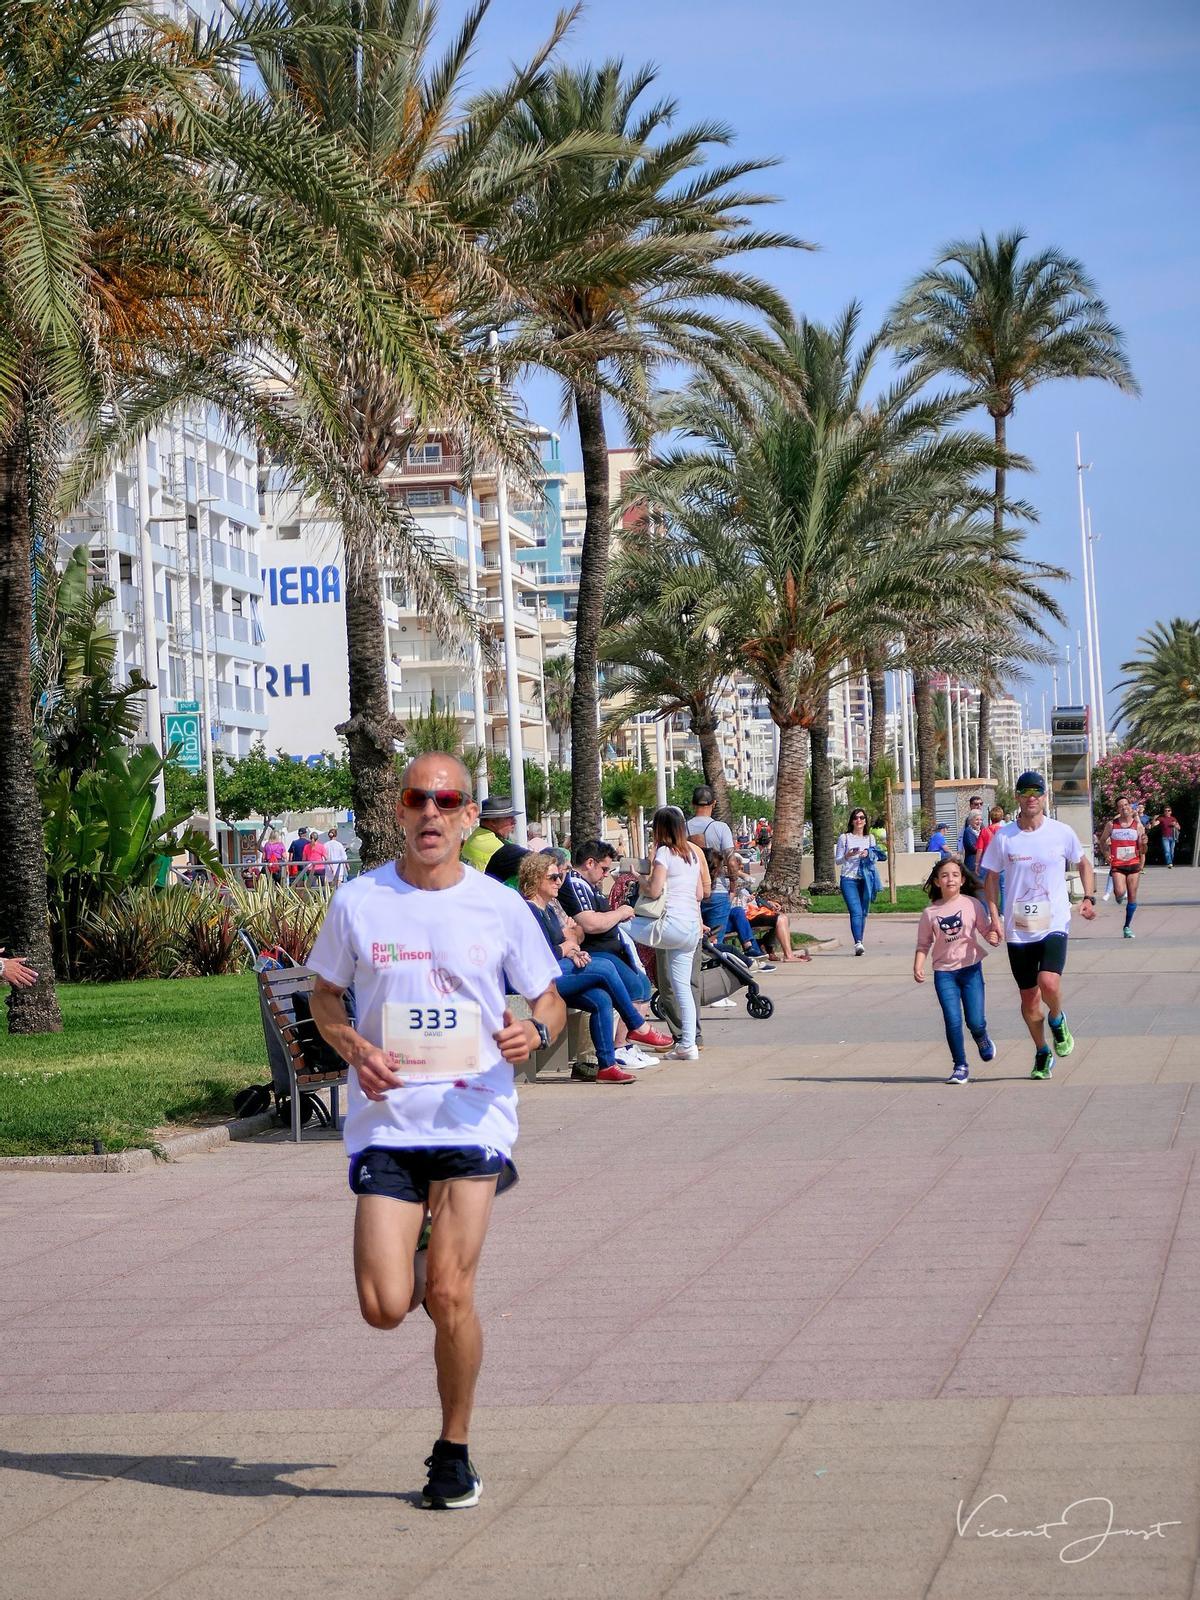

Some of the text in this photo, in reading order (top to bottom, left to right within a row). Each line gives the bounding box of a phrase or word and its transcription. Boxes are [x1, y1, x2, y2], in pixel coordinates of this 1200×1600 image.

[169, 720, 198, 737] AQ
[1024, 904, 1039, 914] 92
[372, 942, 395, 953] Run
[372, 949, 432, 964] Parkinson
[409, 1008, 458, 1030] 333
